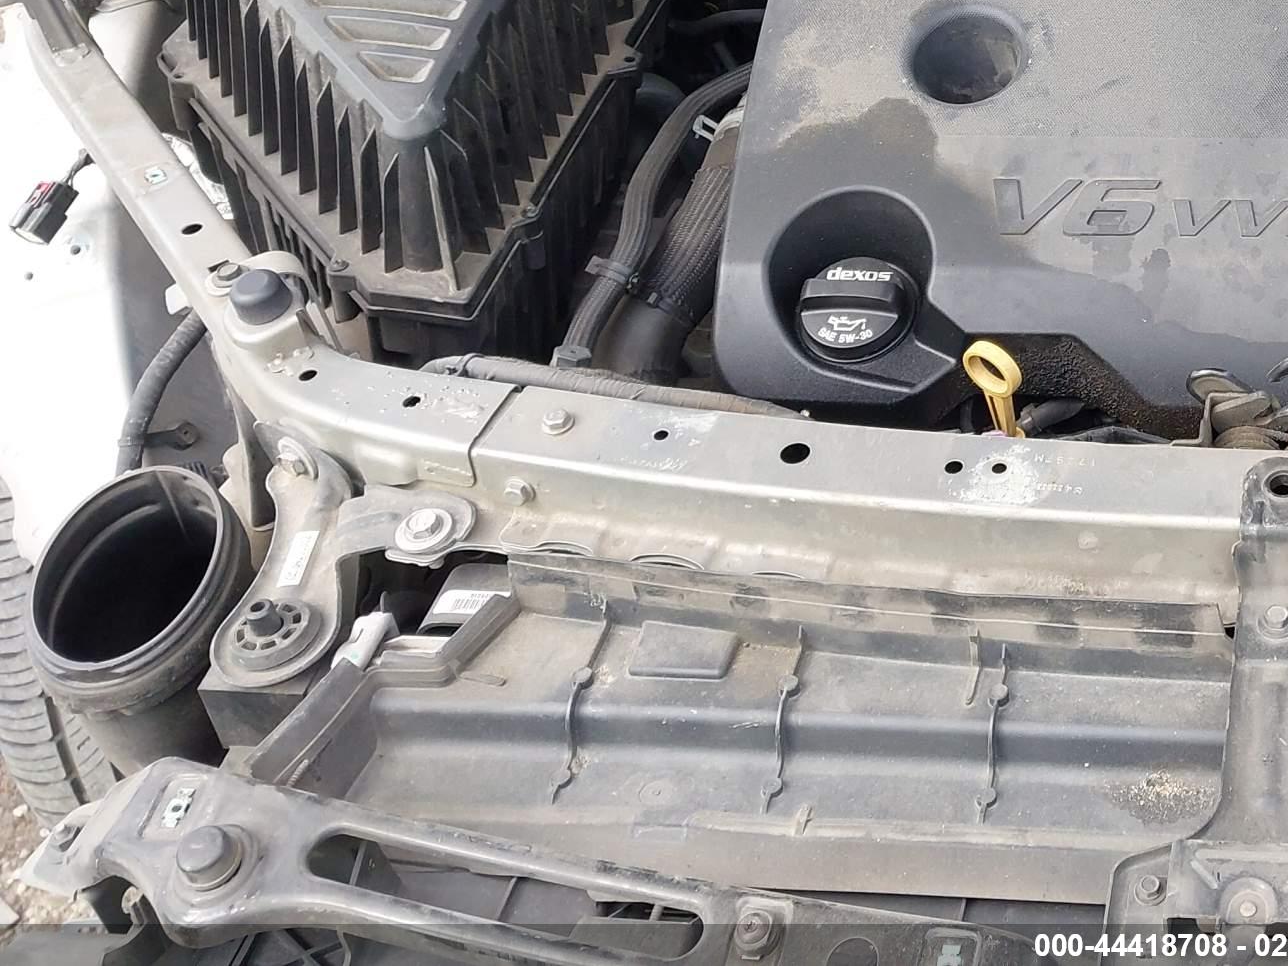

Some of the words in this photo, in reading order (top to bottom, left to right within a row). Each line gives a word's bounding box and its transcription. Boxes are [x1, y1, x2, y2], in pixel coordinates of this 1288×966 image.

[993, 178, 1163, 236] V6
[827, 267, 894, 282] dexos
[818, 327, 836, 342] SAE
[838, 329, 874, 343] 5W-30
